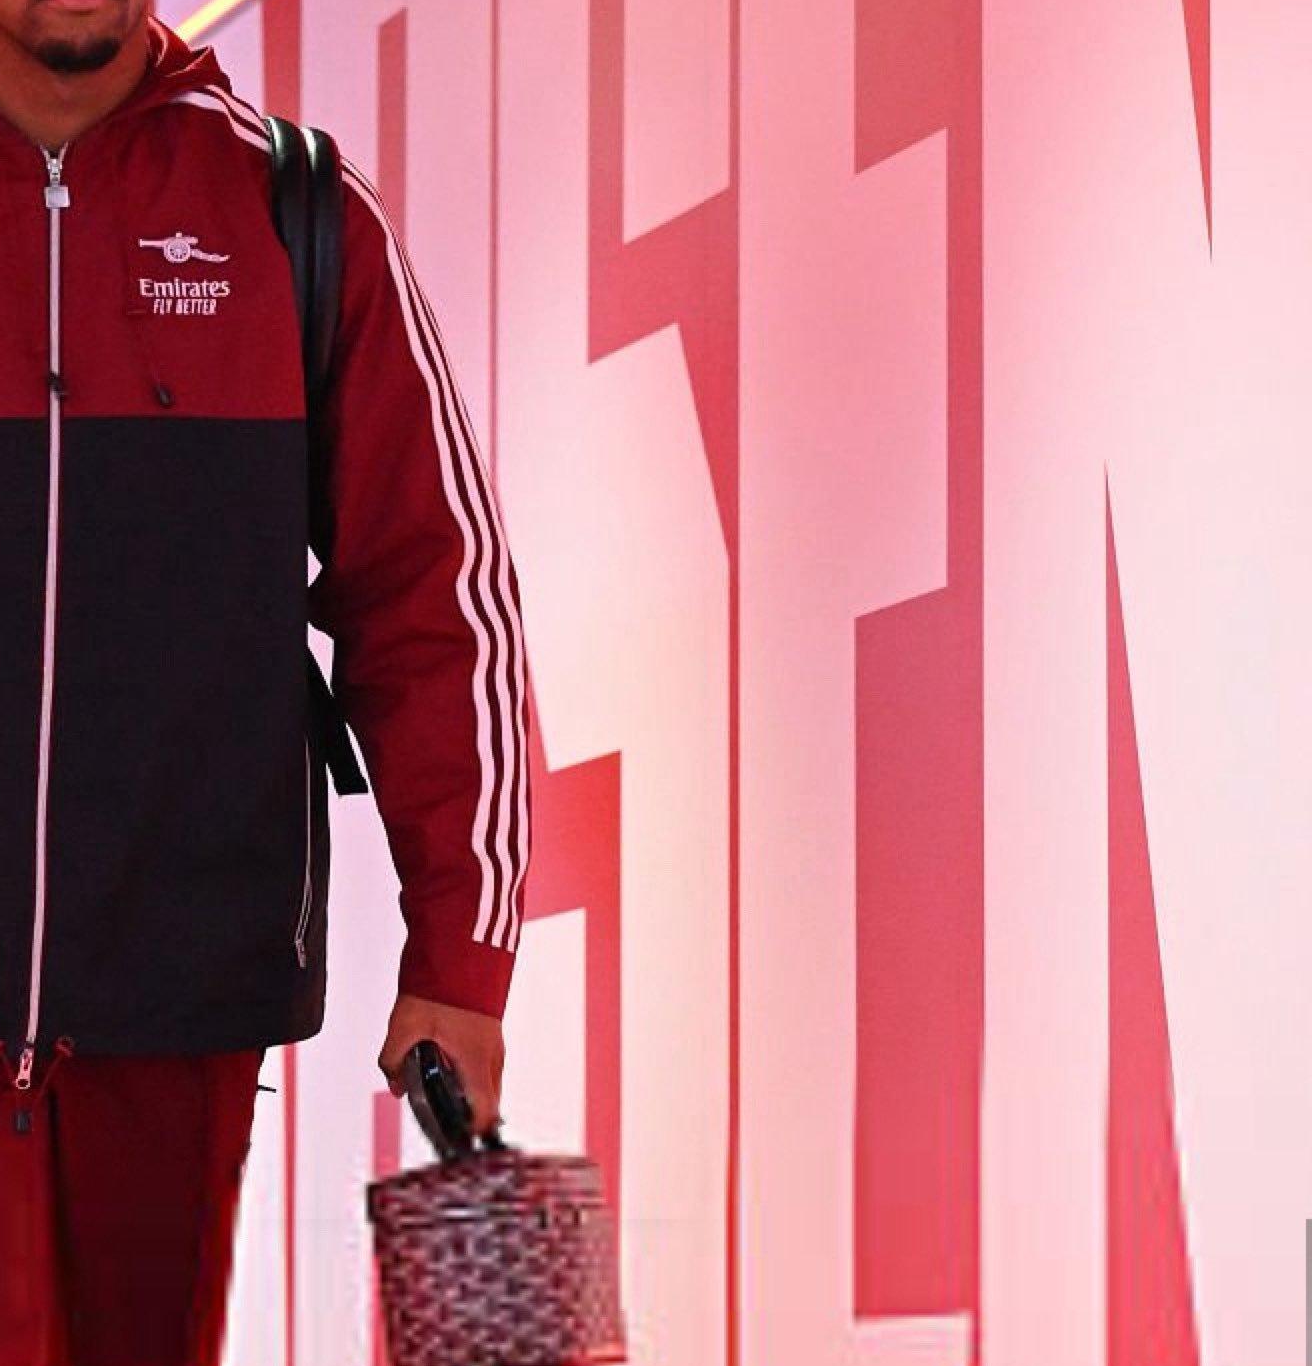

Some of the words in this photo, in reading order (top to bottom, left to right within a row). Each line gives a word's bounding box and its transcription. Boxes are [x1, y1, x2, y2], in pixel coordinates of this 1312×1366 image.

[139, 278, 231, 297] Emirates
[153, 298, 173, 315] FLY
[175, 298, 217, 315] BETTER
